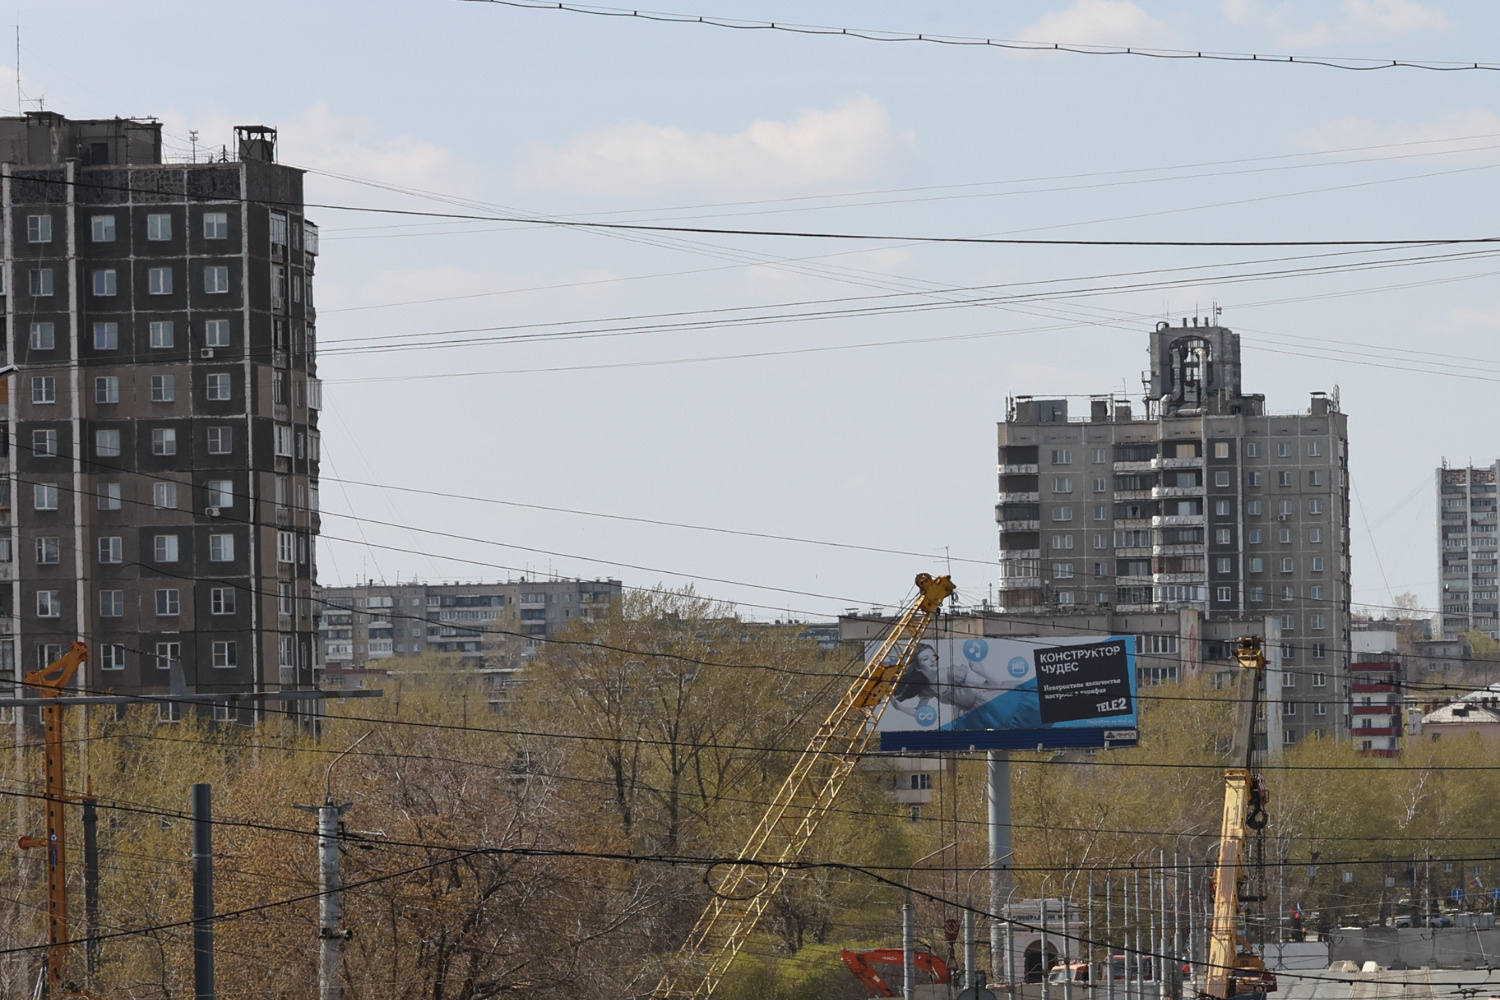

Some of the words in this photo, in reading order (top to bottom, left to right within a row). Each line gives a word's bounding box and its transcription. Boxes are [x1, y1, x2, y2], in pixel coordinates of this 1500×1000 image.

[1040, 646, 1120, 664] КОНСТРУКТОР
[1041, 662, 1079, 675] ЧУДЕС
[1096, 698, 1127, 712] TELE2
